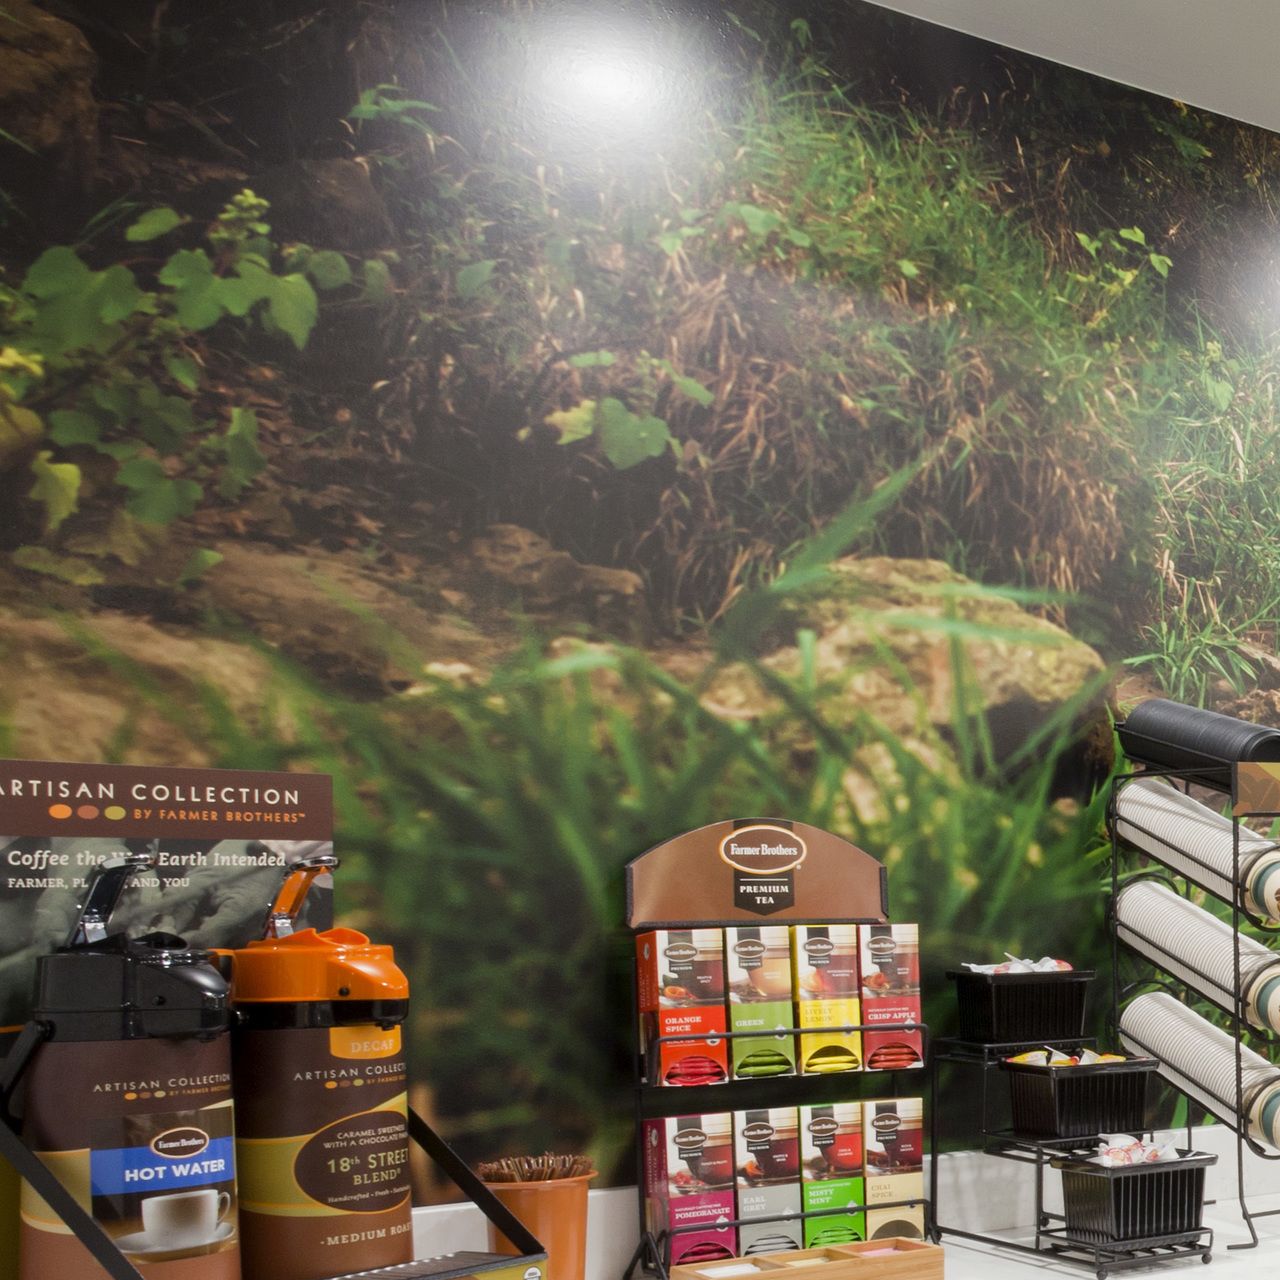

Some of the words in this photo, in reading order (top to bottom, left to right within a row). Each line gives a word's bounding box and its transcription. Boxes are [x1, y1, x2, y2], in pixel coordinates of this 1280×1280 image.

[131, 784, 299, 805] COLLECTION
[133, 808, 152, 819] BY
[159, 809, 219, 822] FARMER
[730, 843, 760, 856] Farmer
[761, 843, 798, 856] Brothers
[7, 849, 70, 870] Coffee
[158, 851, 207, 867] Earth
[214, 851, 286, 867] Intended
[7, 877, 69, 890] FARMER,
[131, 878, 160, 888] AND
[162, 877, 190, 888] YOU
[740, 885, 789, 893] PREMIUM
[755, 896, 774, 904] TEA
[665, 1016, 702, 1025] ORANGE
[736, 1018, 764, 1027] GREEN
[868, 1013, 891, 1021] CRISP
[666, 1025, 691, 1033] SPICE
[351, 1040, 394, 1053] DECAF
[294, 1068, 359, 1080] ARTISAN
[93, 1080, 160, 1092] ARTISAN
[168, 1073, 231, 1087] COLLECTION
[337, 1129, 376, 1140] CARAMEL
[323, 1141, 347, 1149] WITH
[327, 1155, 361, 1174] 18th
[367, 1148, 409, 1169] STREET
[124, 1166, 167, 1182] HOT
[171, 1158, 225, 1178] WATER
[809, 1188, 834, 1197] MISTY
[871, 1191, 892, 1199] SPICE
[744, 1196, 765, 1204] EARL
[809, 1197, 829, 1205] MINT
[675, 1207, 731, 1220] POMEGRANATE
[744, 1204, 766, 1212] GREY
[327, 1228, 387, 1246] MEDIUM
